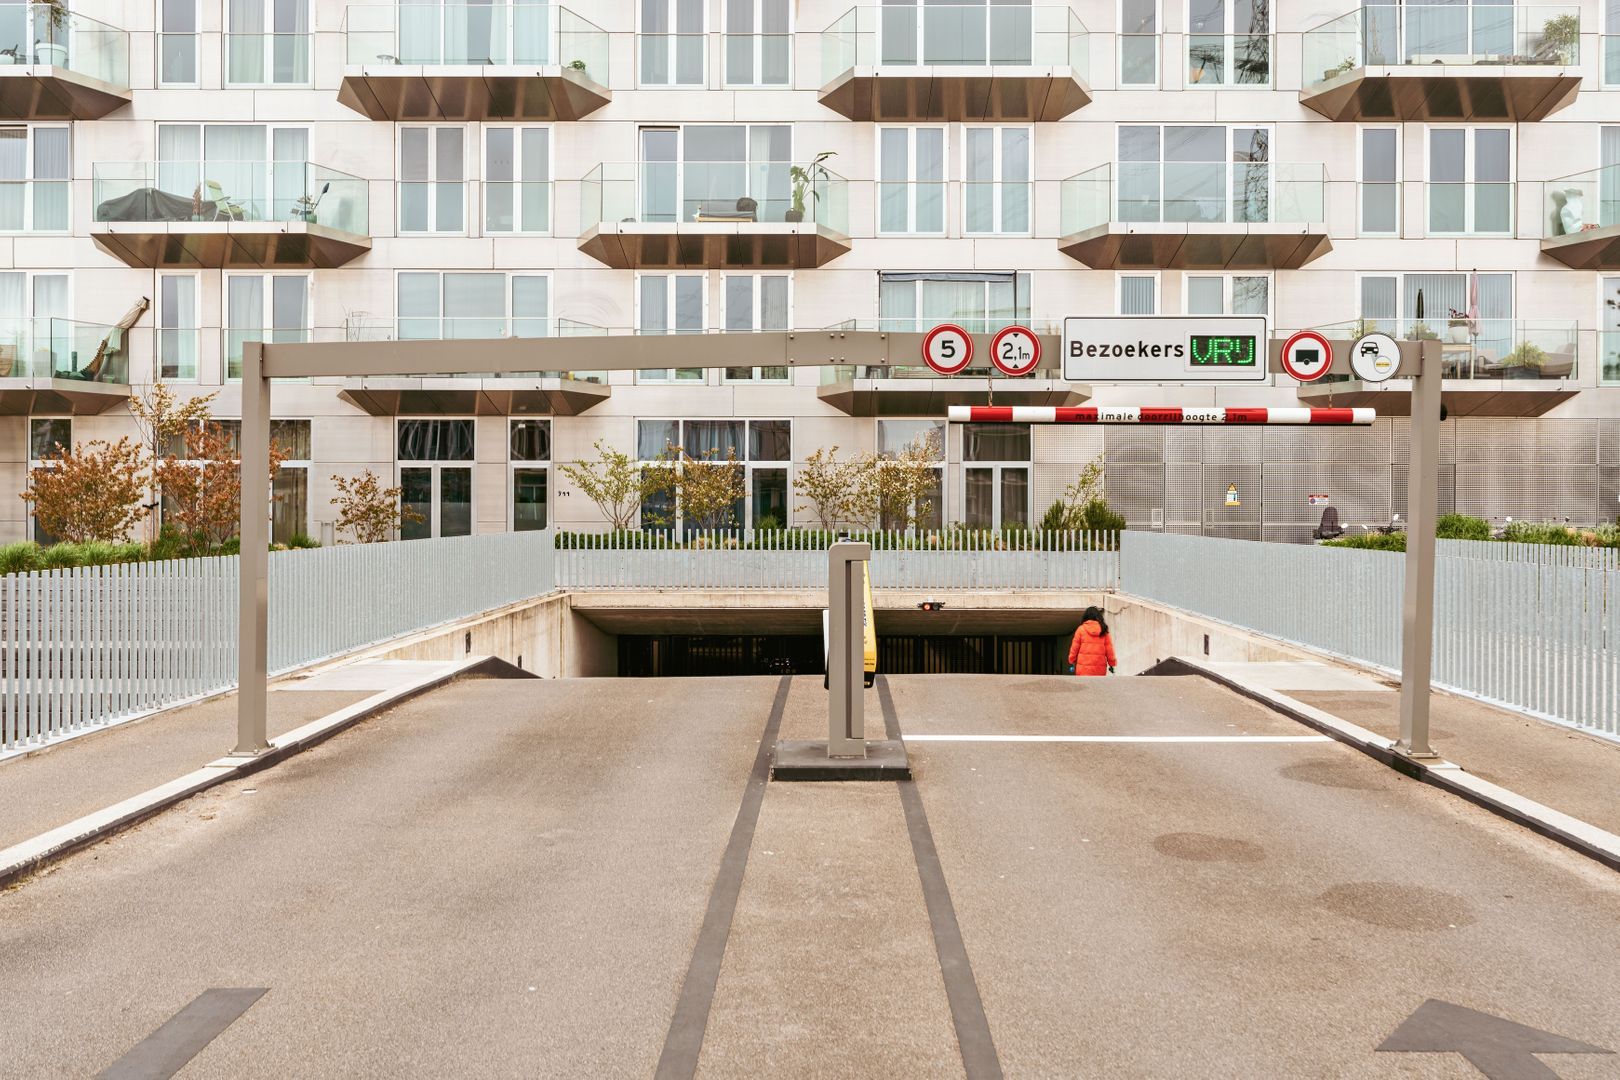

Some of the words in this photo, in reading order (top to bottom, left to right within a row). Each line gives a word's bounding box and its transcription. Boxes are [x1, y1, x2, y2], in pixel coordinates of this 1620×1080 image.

[941, 340, 956, 358] 5
[1070, 340, 1184, 358] Bezoekers
[1075, 412, 1134, 421] maximale
